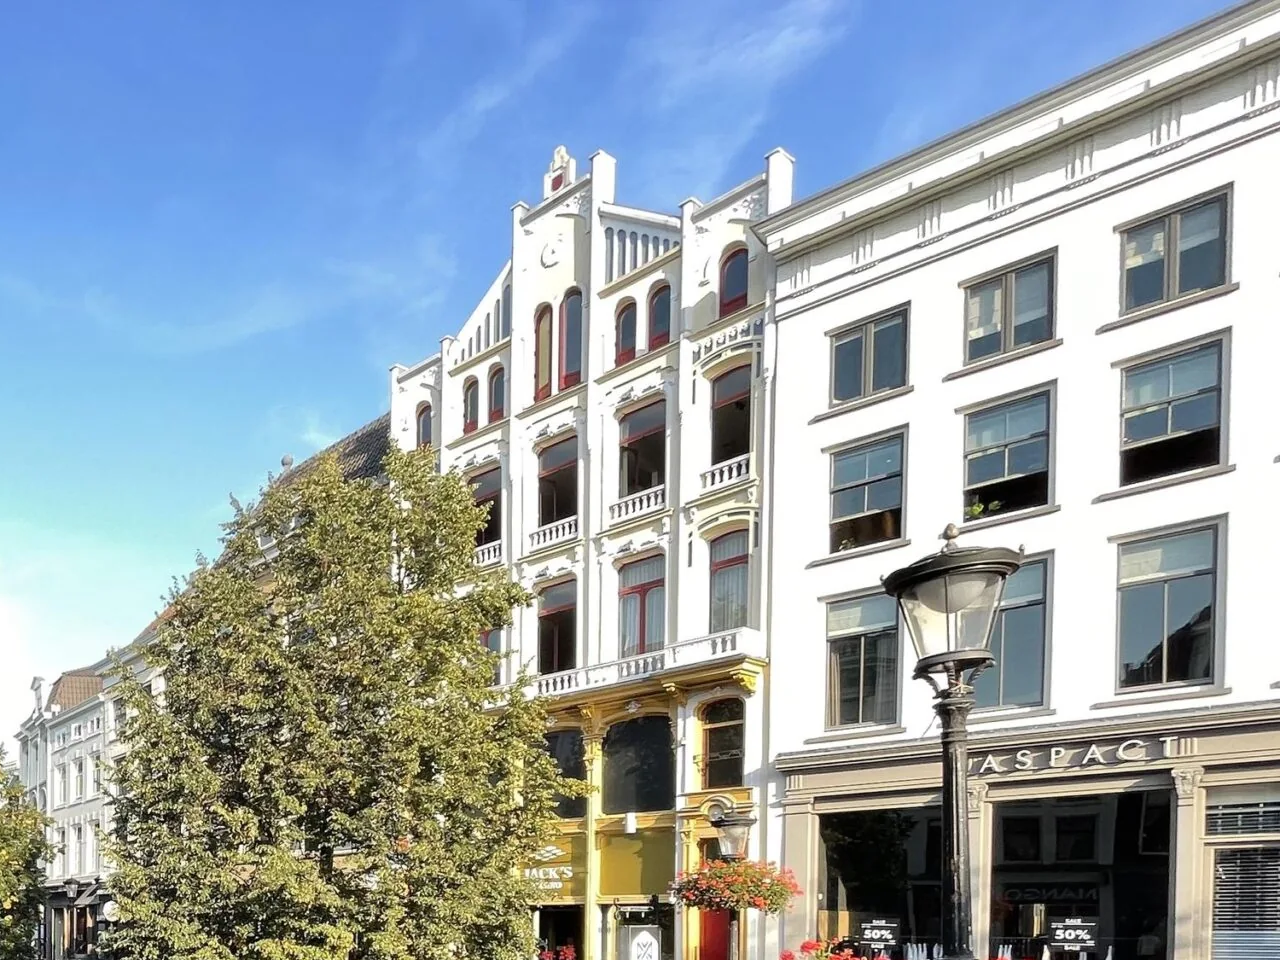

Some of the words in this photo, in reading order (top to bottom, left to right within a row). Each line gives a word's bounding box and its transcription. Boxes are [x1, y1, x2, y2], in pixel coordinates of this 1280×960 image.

[980, 736, 1178, 773] ASPACT
[863, 929, 893, 939] 50%
[1054, 929, 1091, 940] 50%
